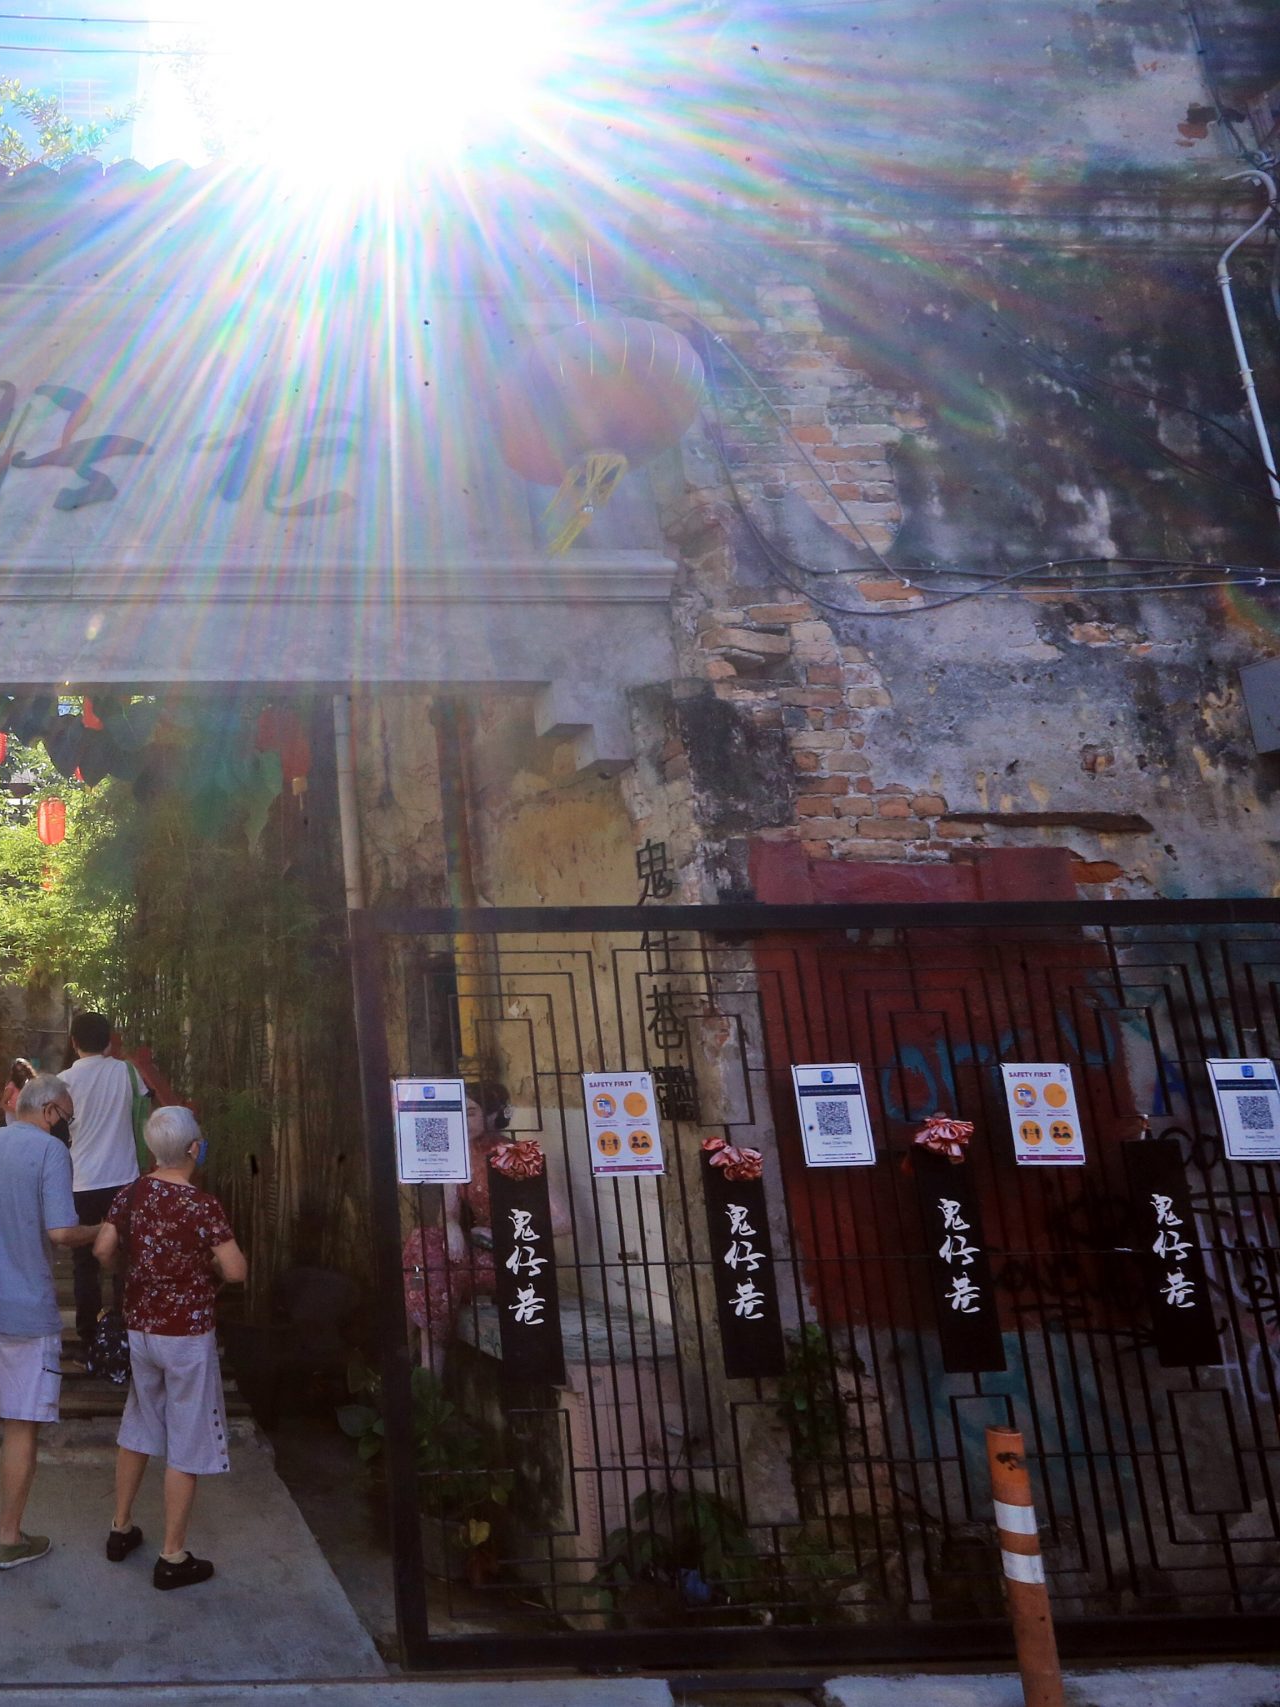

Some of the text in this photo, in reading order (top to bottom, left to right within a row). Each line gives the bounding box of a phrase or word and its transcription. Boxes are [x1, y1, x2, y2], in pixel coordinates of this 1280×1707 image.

[505, 1208, 549, 1325] 鬼仔巷
[724, 1203, 767, 1319] 鬼仔巷
[937, 1198, 981, 1313] 鬼仔巷
[1149, 1193, 1196, 1308] 鬼仔巷
